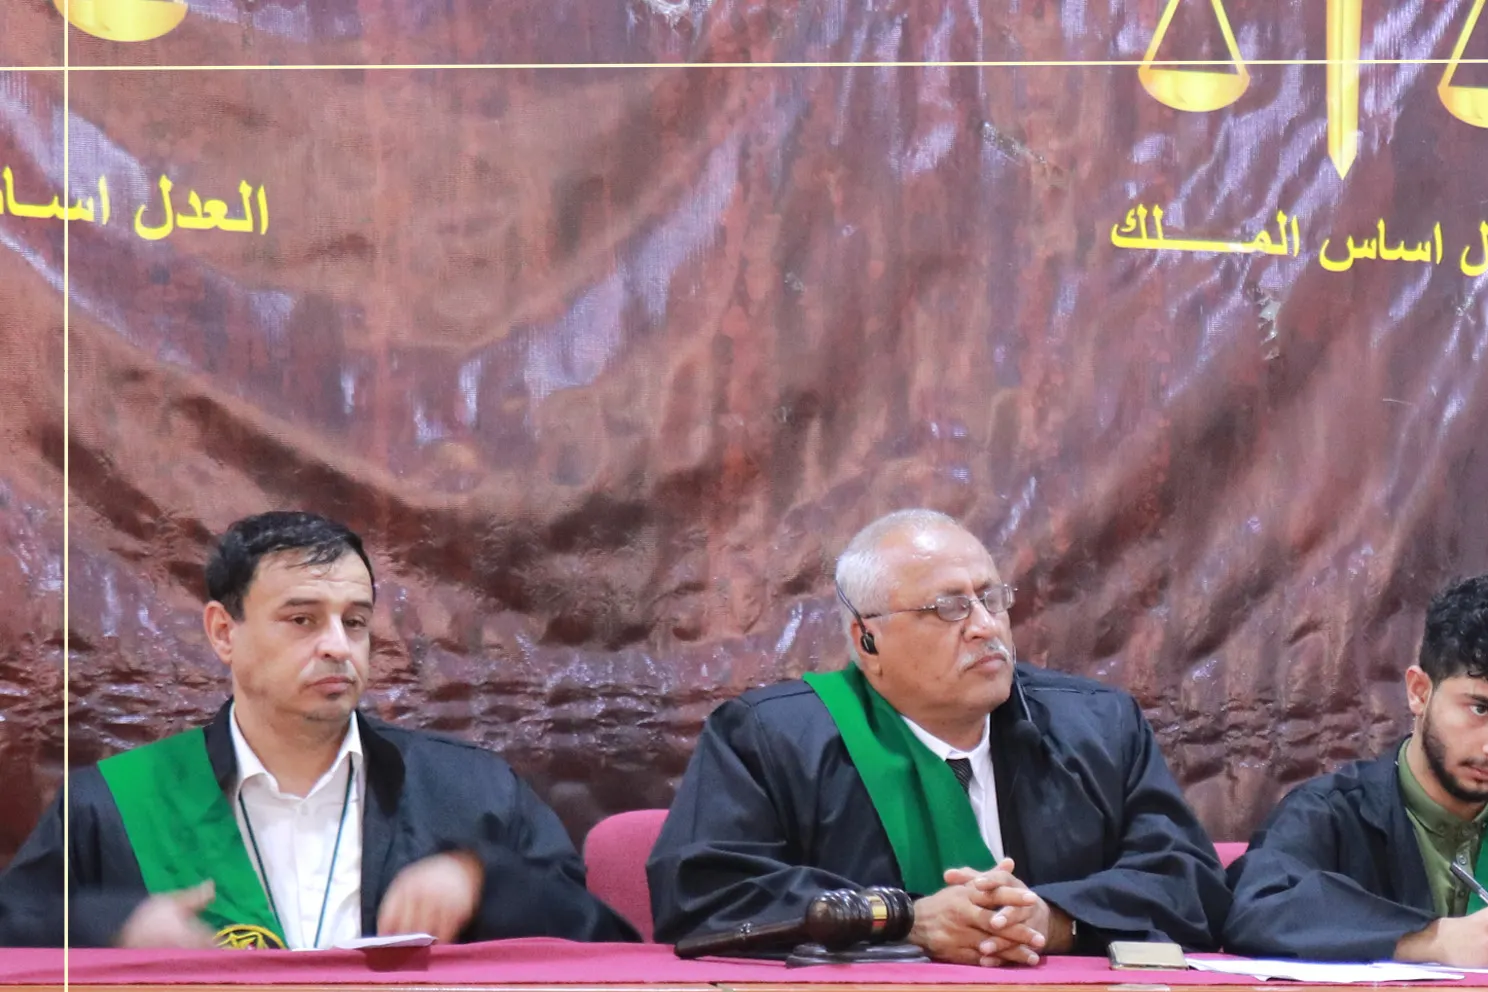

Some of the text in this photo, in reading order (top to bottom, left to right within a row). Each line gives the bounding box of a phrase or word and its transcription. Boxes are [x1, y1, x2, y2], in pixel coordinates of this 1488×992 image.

[0, 165, 269, 241] العدل اسا
[1110, 203, 1300, 258] الملك
[1319, 217, 1444, 272] اساس
